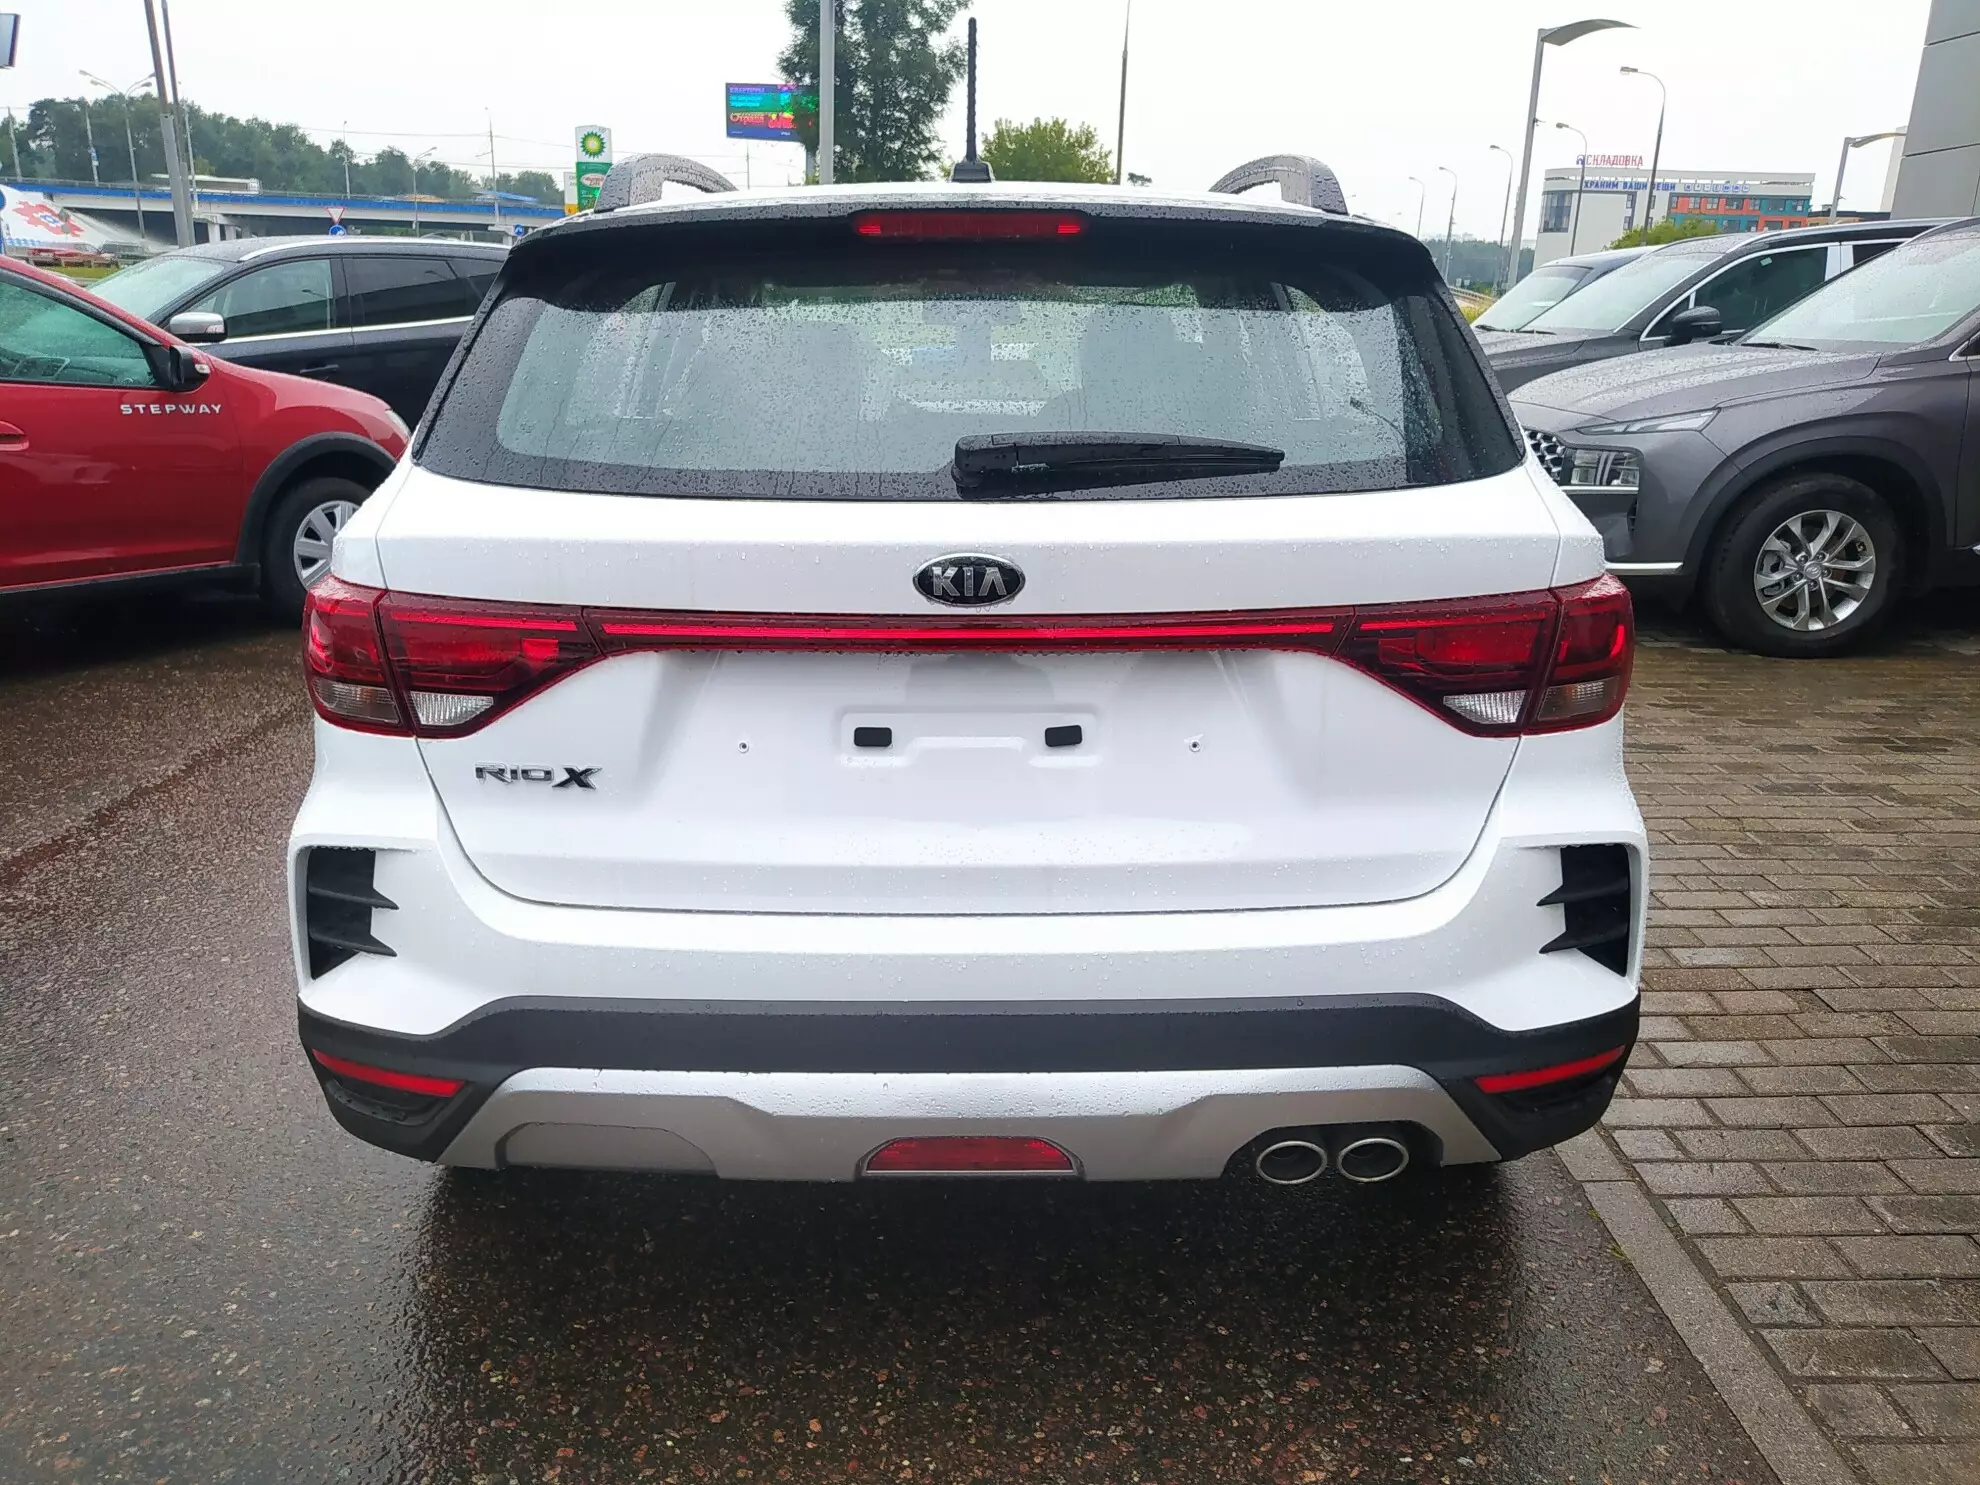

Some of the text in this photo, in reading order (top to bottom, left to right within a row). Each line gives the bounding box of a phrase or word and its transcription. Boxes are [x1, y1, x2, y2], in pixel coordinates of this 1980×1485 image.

[1586, 154, 1644, 167] СКЛАДОВКА
[1583, 180, 1619, 190] ХРАНИМ
[1622, 181, 1648, 191] ВАШИ
[120, 404, 221, 415] STEPWAY
[931, 566, 1007, 597] KIA
